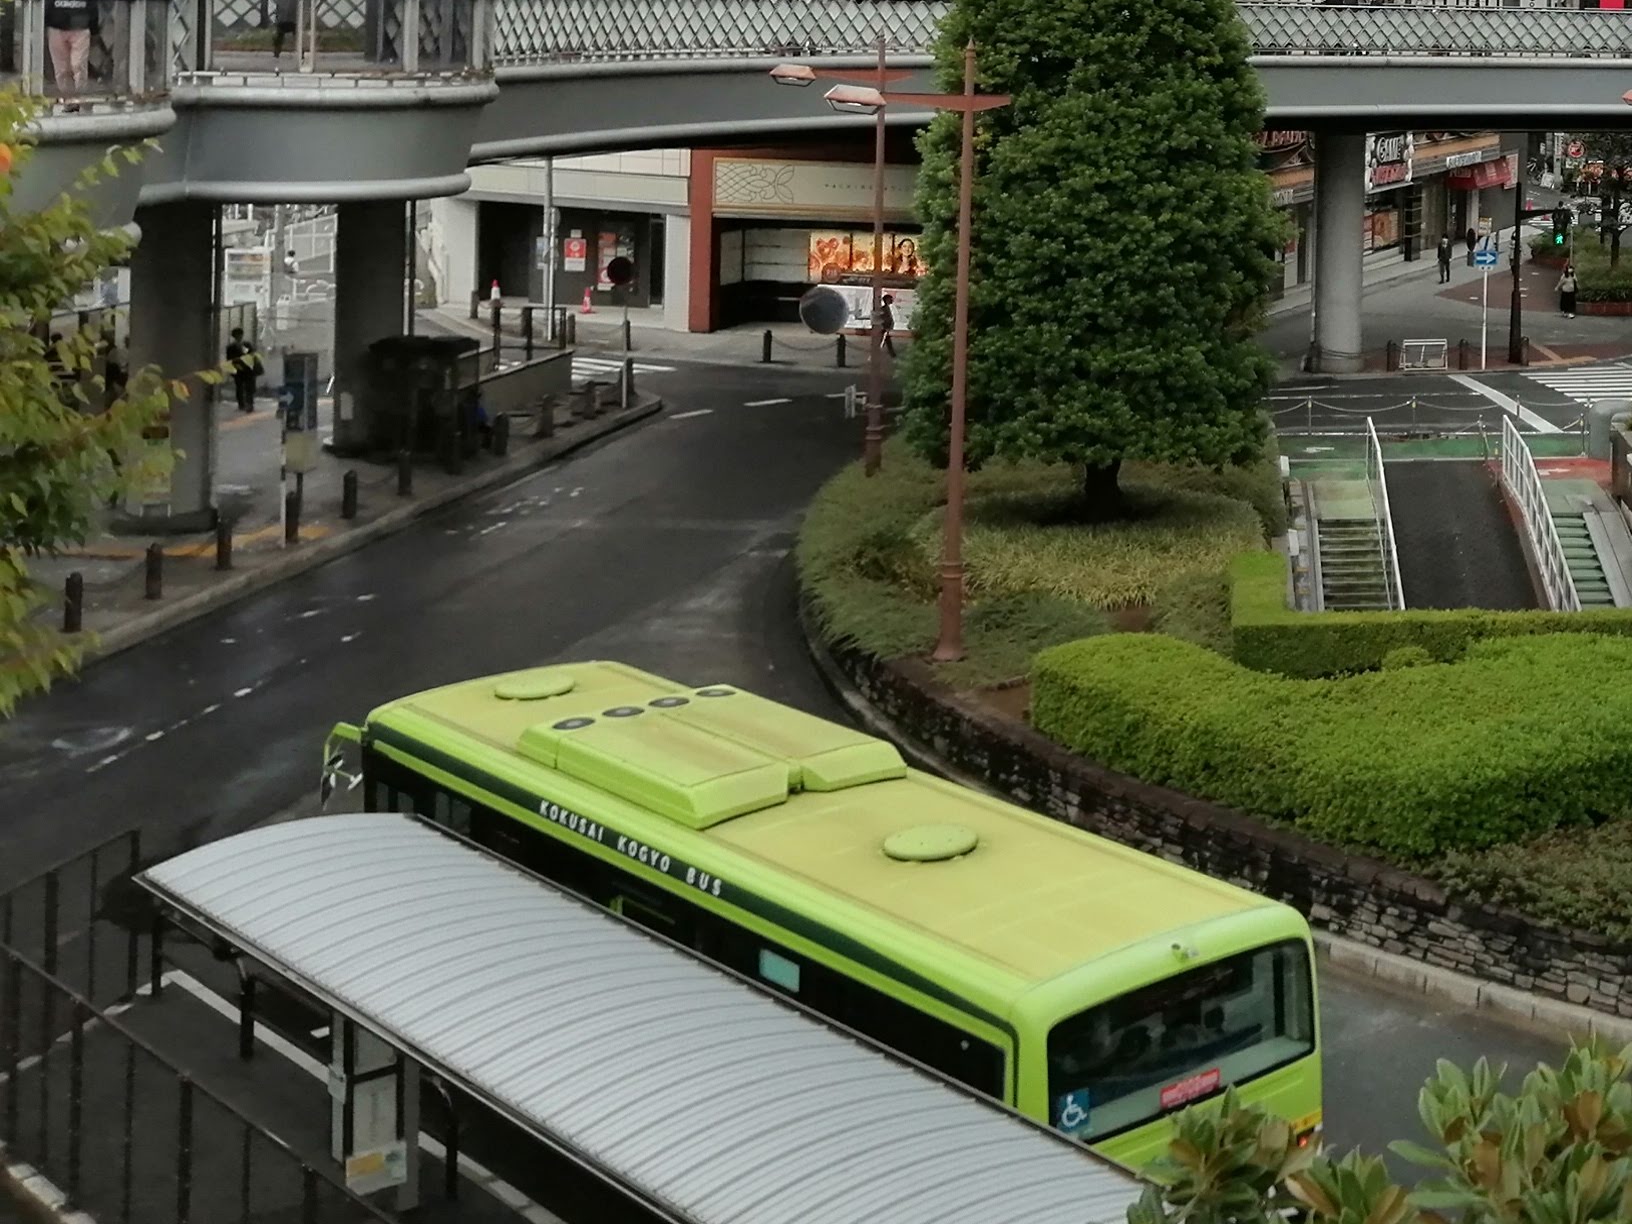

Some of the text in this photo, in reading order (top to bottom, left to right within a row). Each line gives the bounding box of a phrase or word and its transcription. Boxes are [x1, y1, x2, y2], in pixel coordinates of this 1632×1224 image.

[539, 799, 722, 897] KOKUSAI KOGYO BUS
